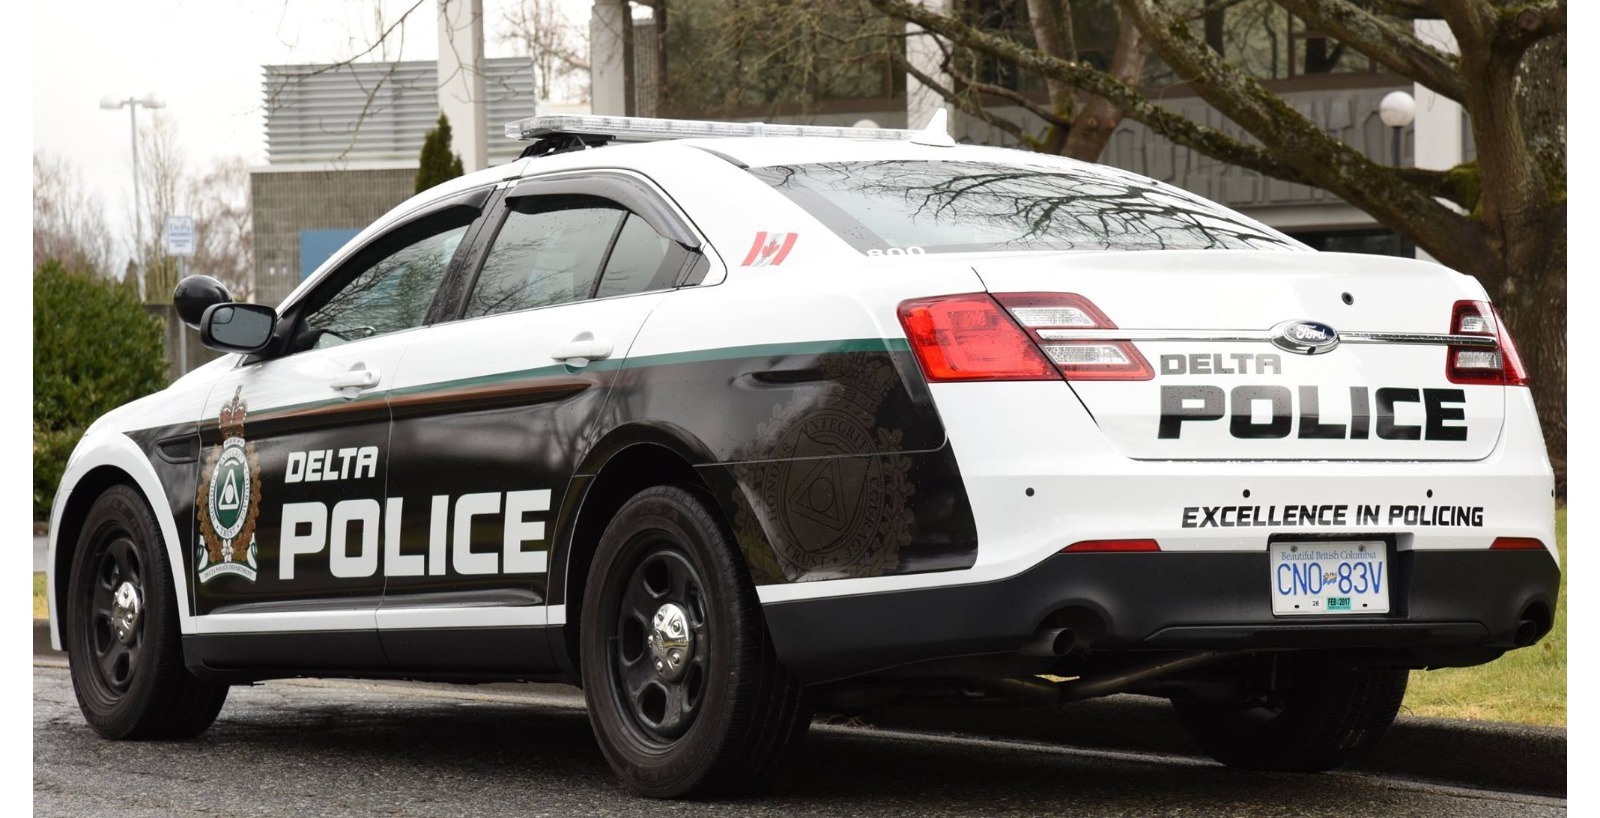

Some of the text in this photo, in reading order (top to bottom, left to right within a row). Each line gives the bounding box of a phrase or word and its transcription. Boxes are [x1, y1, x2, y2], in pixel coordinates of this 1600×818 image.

[1296, 324, 1326, 339] Ford
[1160, 353, 1281, 375] DELTA
[1158, 385, 1468, 441] POLICE
[803, 416, 873, 452] INTEGRIT
[285, 446, 379, 483] DELTA
[1181, 505, 1484, 528] EXCELLENCE IN POLICING
[279, 489, 552, 580] POLICE
[784, 541, 829, 569] TRUST
[1281, 550, 1376, 561] Beautiful British Columbia
[1338, 561, 1382, 594] 83V
[1327, 597, 1350, 606] FEB 2017
